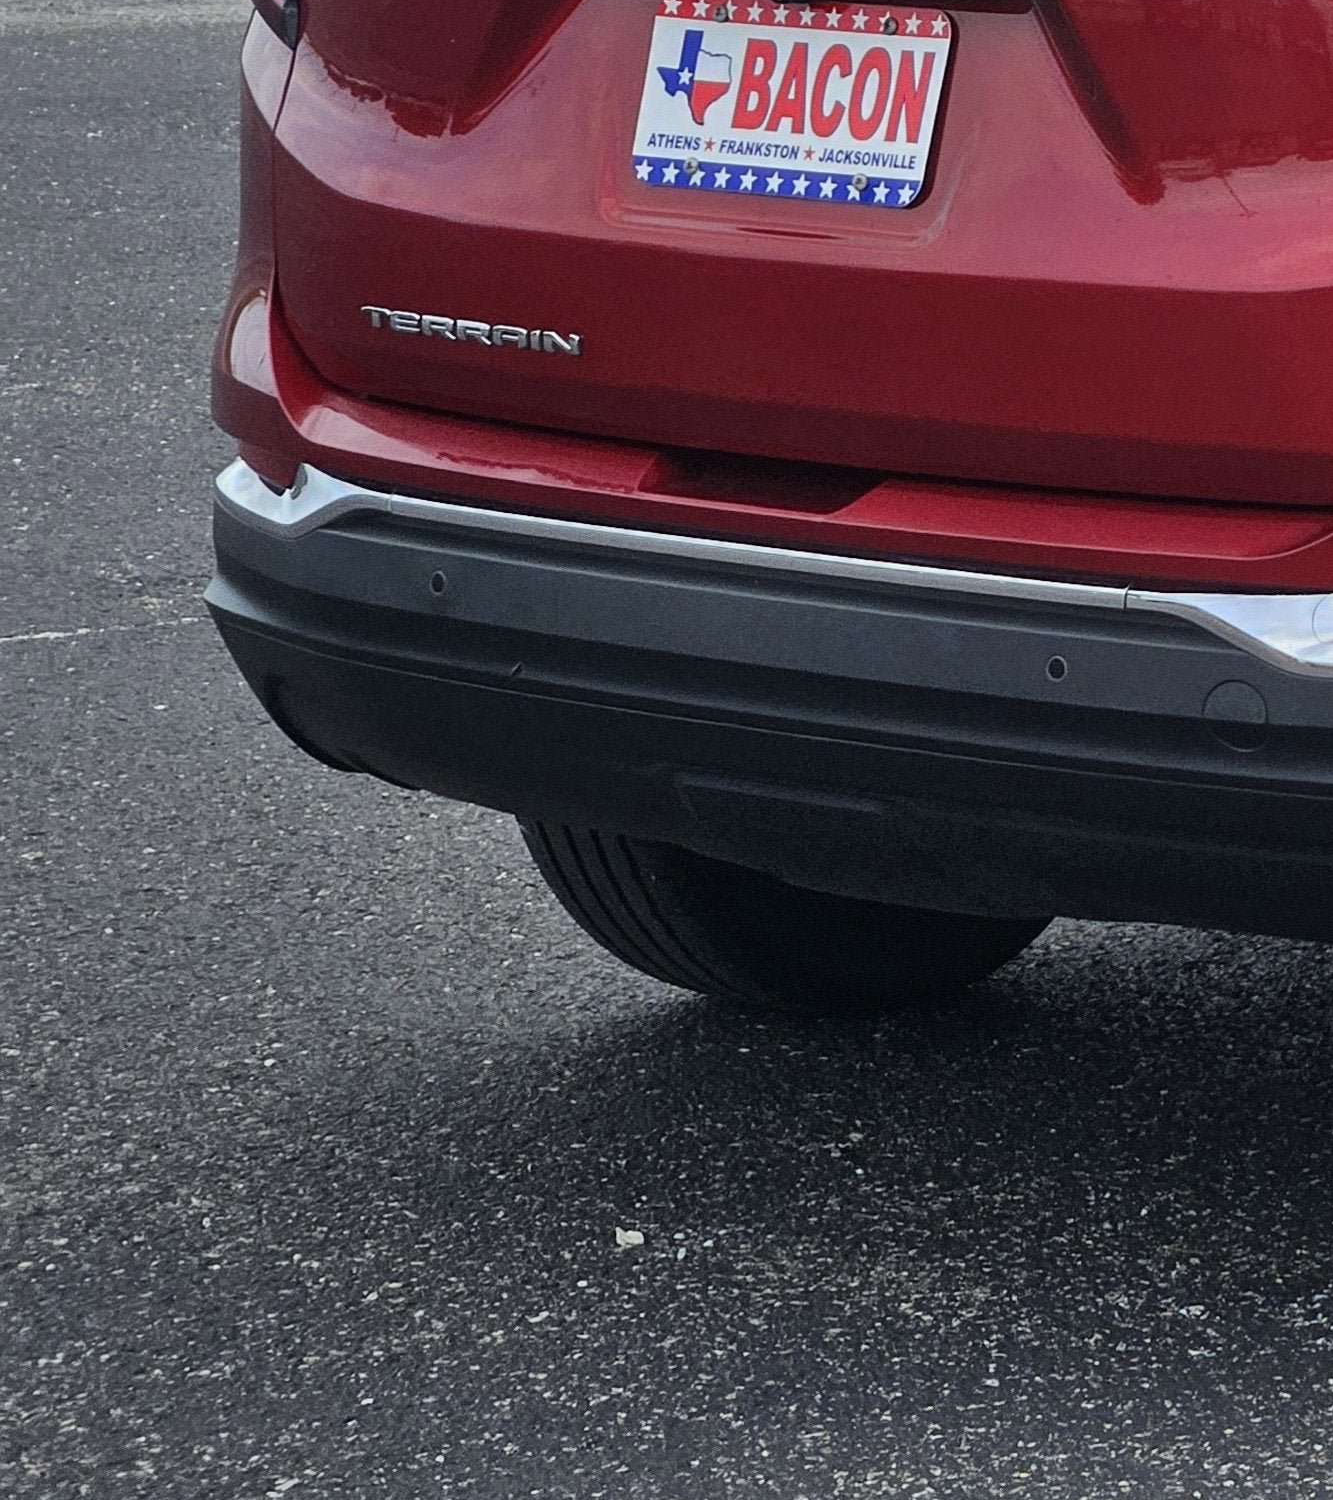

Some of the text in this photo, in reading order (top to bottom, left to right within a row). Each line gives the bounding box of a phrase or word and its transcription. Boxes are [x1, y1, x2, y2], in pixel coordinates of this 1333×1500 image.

[731, 37, 937, 145] BACON
[647, 132, 917, 170] ATHENS FRANKSTON JACKSONVILLE
[360, 305, 583, 356] TERRAIN
